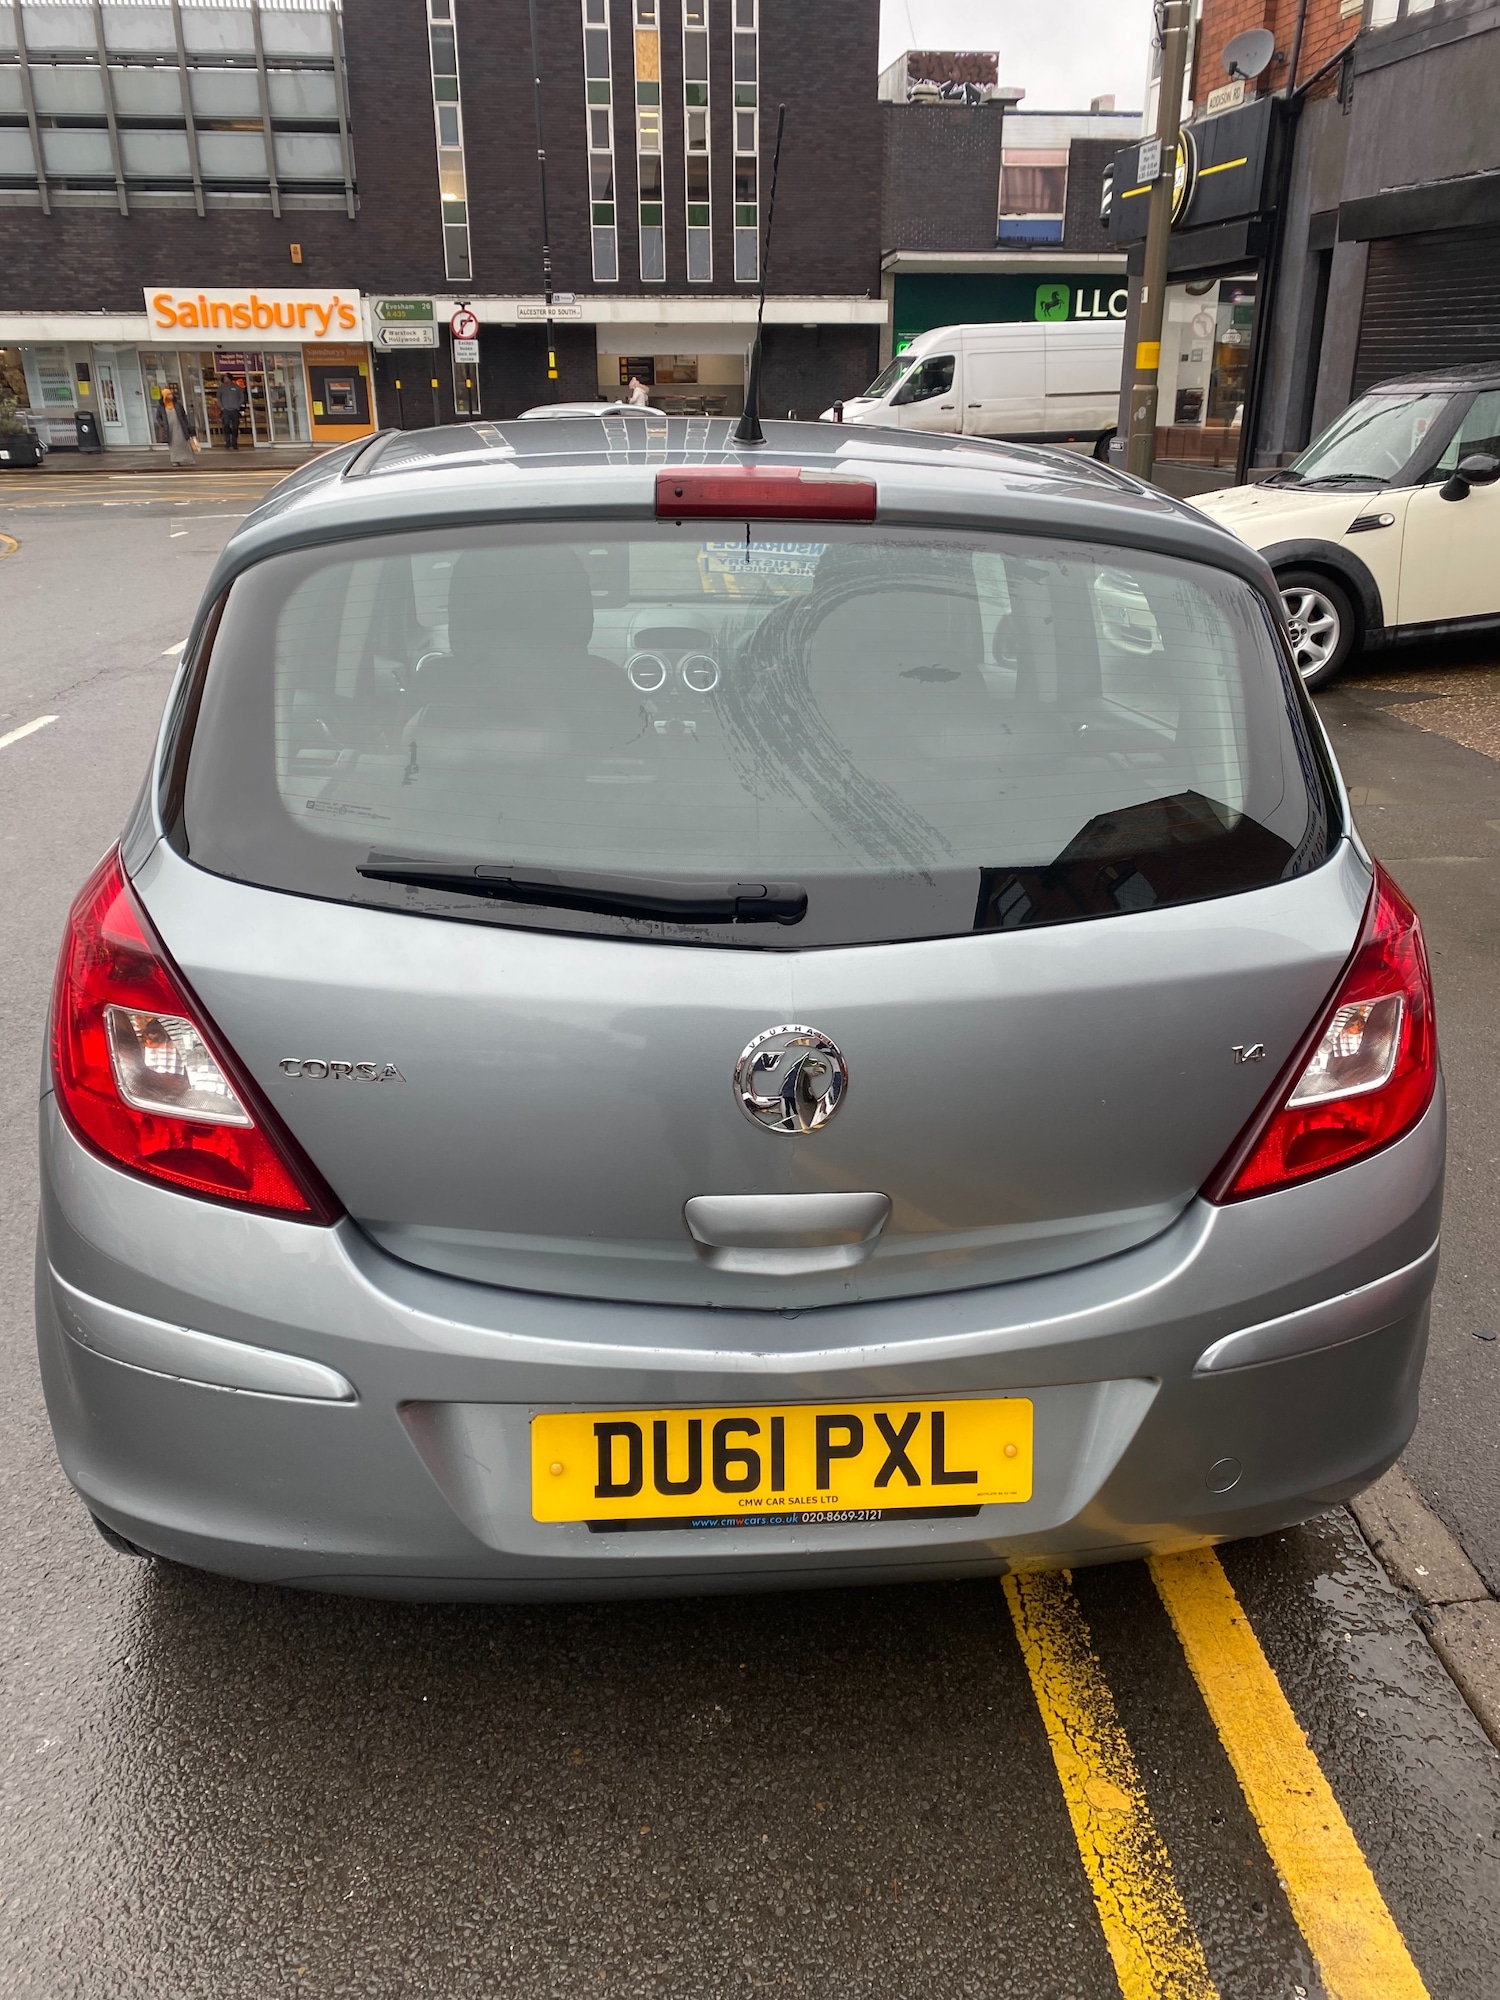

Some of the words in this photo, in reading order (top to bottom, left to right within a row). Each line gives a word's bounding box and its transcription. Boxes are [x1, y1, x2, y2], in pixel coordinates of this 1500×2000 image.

[1209, 91, 1232, 108] ADDISON
[1233, 86, 1241, 100] RD
[152, 293, 356, 337] Sainsbury's
[279, 1057, 406, 1083] CORSA
[594, 1416, 785, 1499] DU61
[815, 1411, 978, 1491] PXL
[738, 1499, 763, 1507] CMW
[765, 1498, 786, 1506] CAR
[787, 1497, 818, 1505] SALES
[820, 1496, 839, 1504] LTD
[692, 1515, 799, 1527] www.cmwcars.co.uk
[801, 1509, 882, 1523] 020-8669-2121
